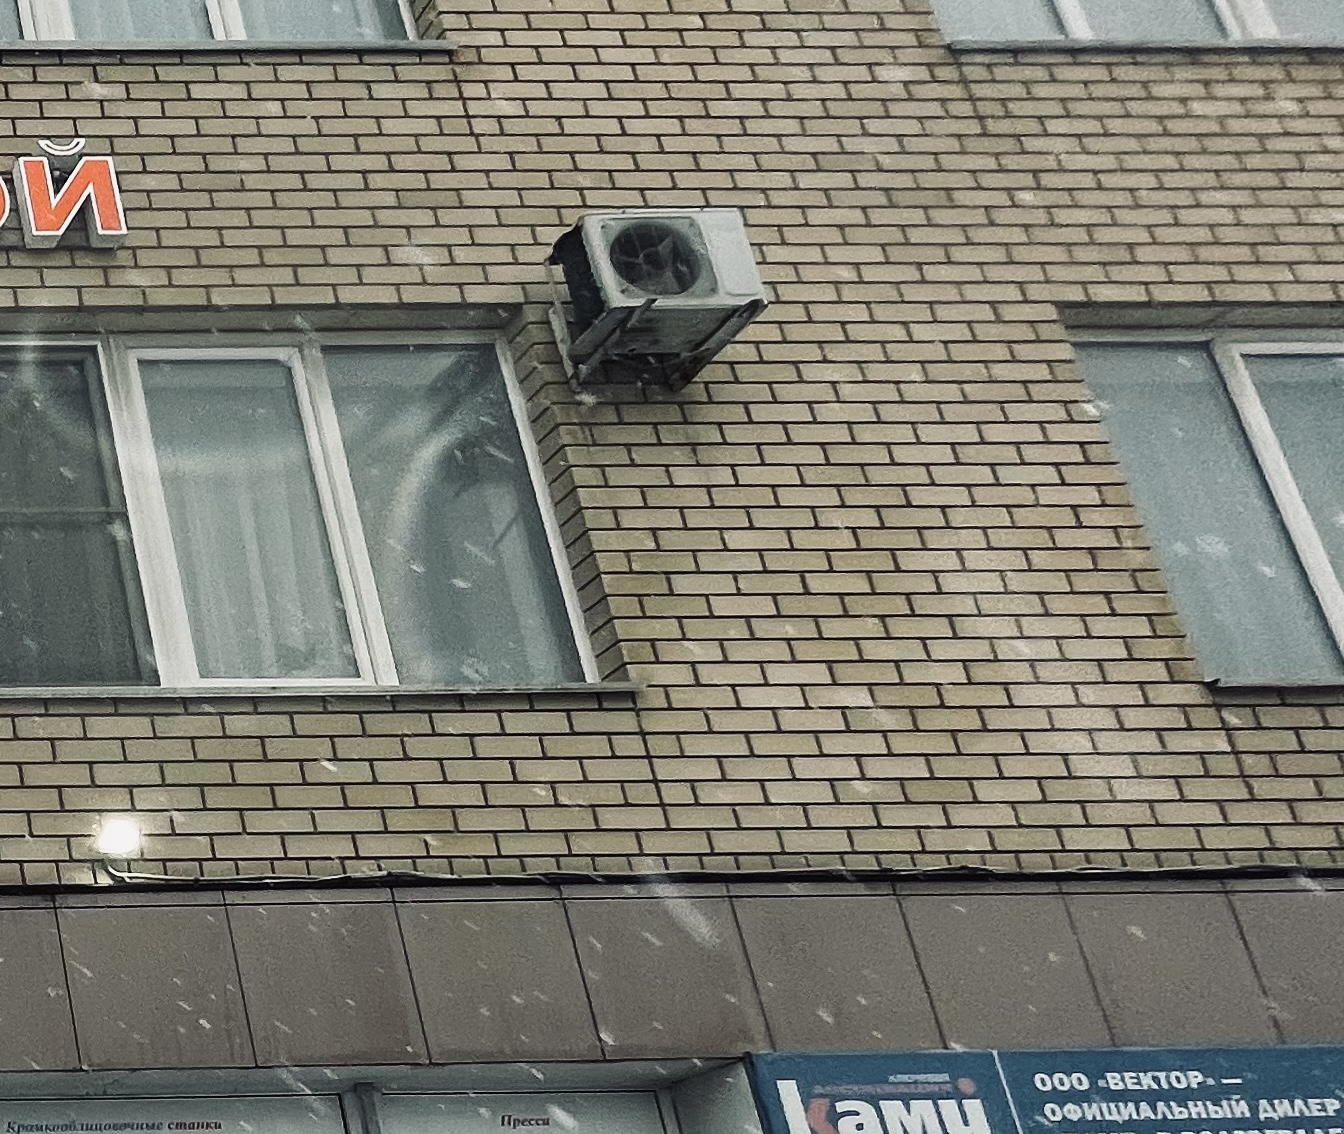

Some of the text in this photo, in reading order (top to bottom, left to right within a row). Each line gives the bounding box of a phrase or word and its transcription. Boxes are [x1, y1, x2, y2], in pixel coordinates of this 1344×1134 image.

[1033, 1072, 1090, 1092] ООО
[1043, 1094, 1341, 1124] ОФИЦИАЛЬНЫЙ ДИЛЕР
[167, 1121, 222, 1131] станки
